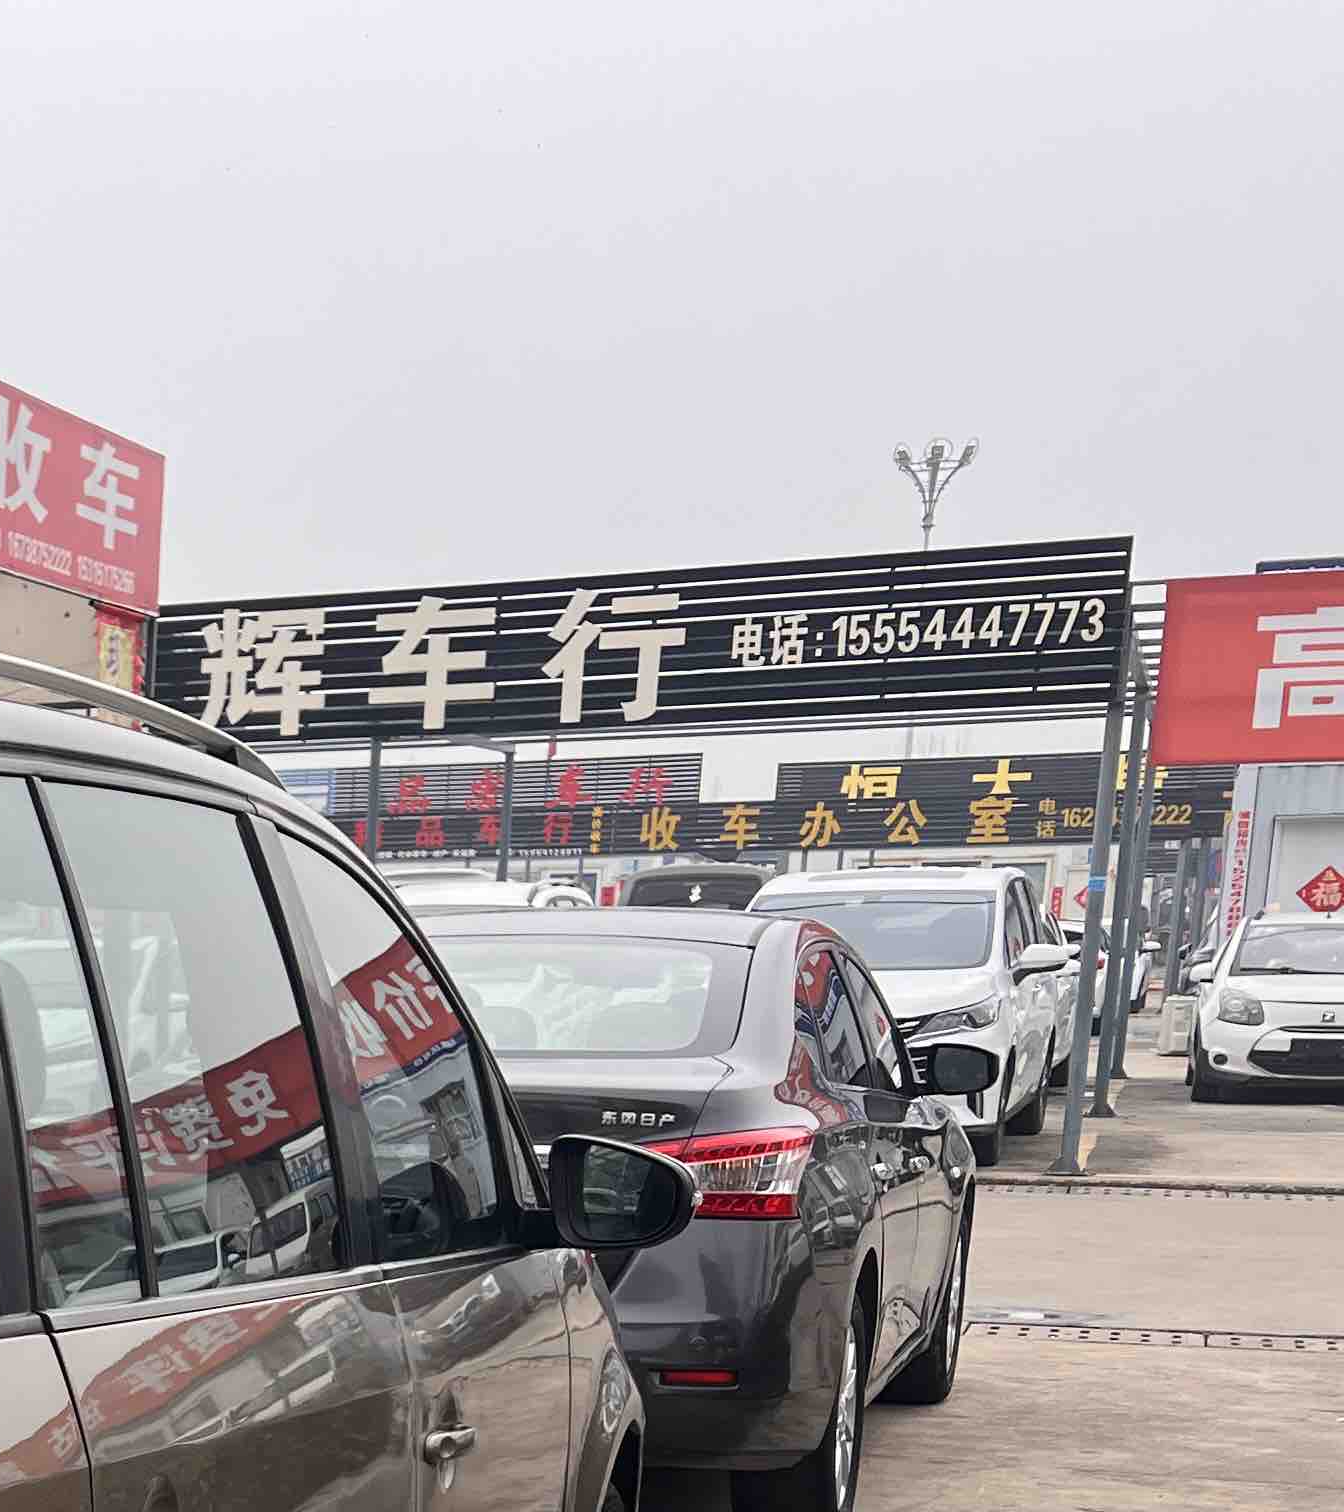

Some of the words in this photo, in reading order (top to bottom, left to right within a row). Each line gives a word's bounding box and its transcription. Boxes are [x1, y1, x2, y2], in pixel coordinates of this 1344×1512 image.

[200, 587, 687, 737] 辉车行
[639, 797, 1011, 852] 收车办公室
[600, 1110, 677, 1129] 东风日产
